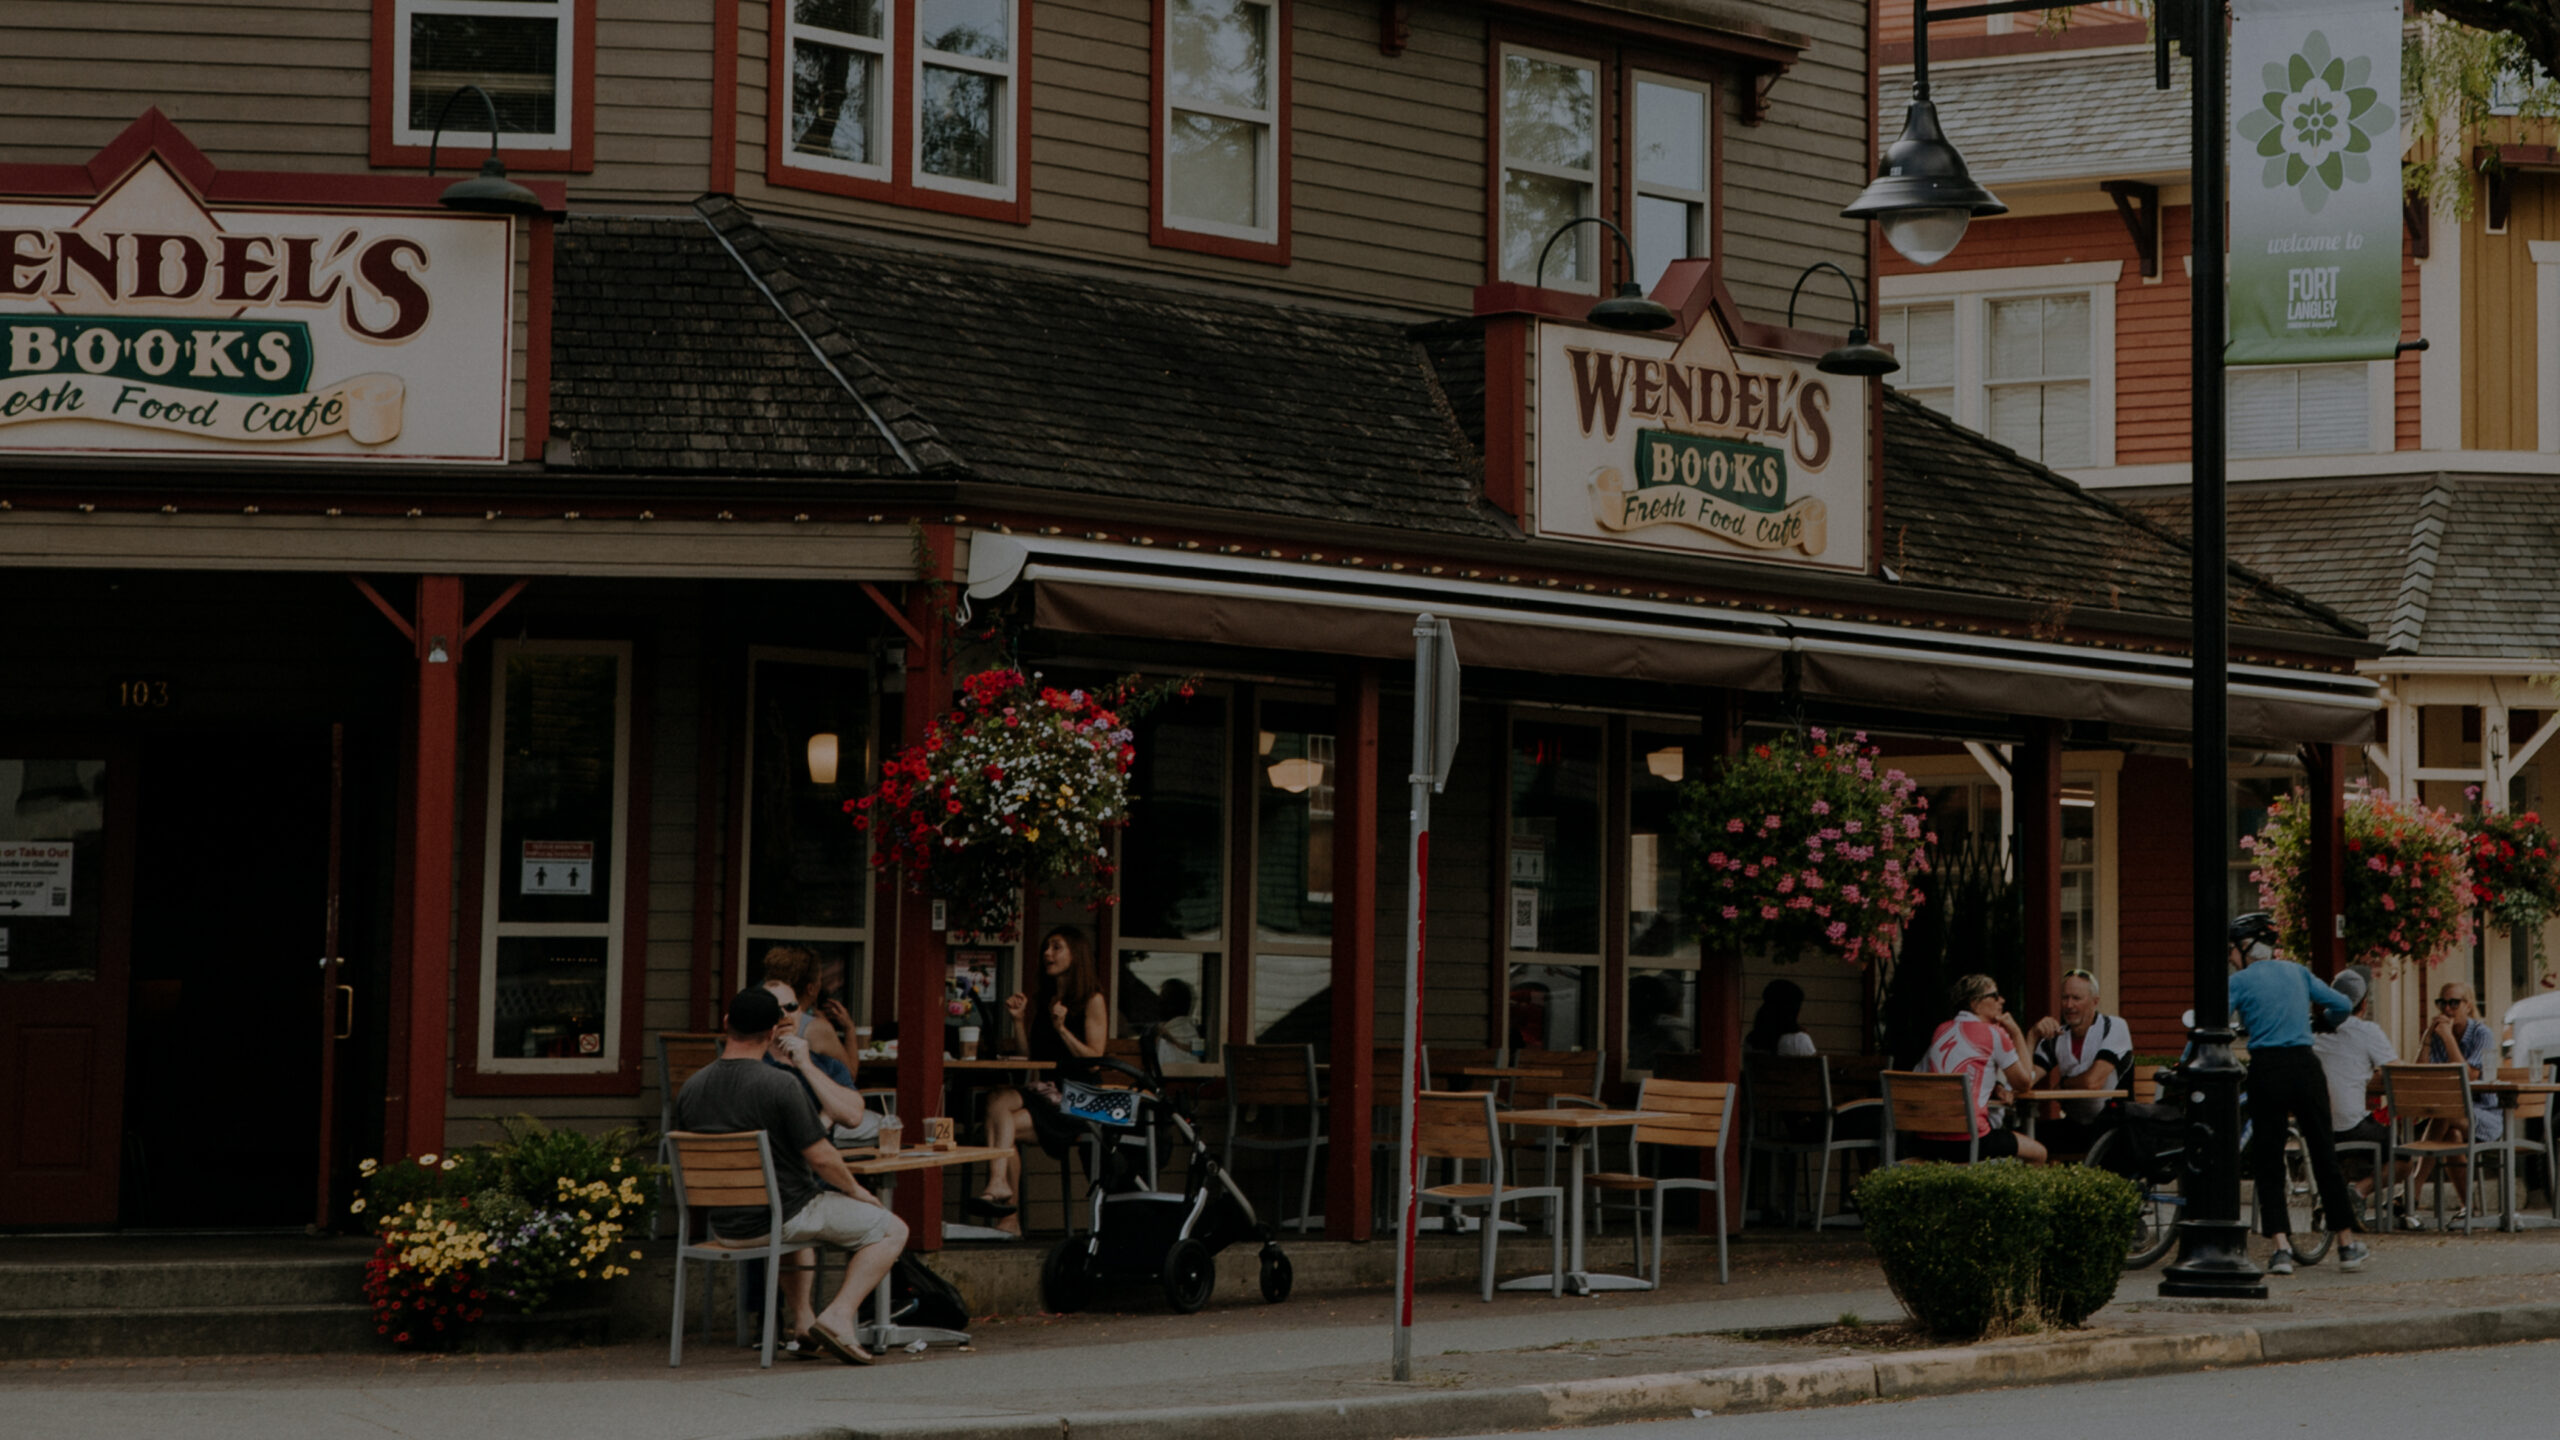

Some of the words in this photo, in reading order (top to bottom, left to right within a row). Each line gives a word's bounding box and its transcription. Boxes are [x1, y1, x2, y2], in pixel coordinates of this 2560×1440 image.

[2267, 231, 2342, 255] welcome
[2345, 230, 2364, 250] to
[0, 230, 430, 340] ENDEL'S
[2287, 266, 2341, 301] FORT
[2286, 300, 2338, 321] LANGLEY
[112, 384, 217, 427] Food
[244, 390, 343, 436] Café
[1565, 347, 1831, 468] WENDEL'S
[1623, 491, 1686, 526] Fresh
[1698, 499, 1746, 536] Food
[1756, 510, 1802, 547] Café
[118, 679, 170, 708] 103
[4, 848, 16, 857] or
[19, 846, 45, 857] Take
[47, 847, 69, 858] Out
[935, 1122, 951, 1140] 26
